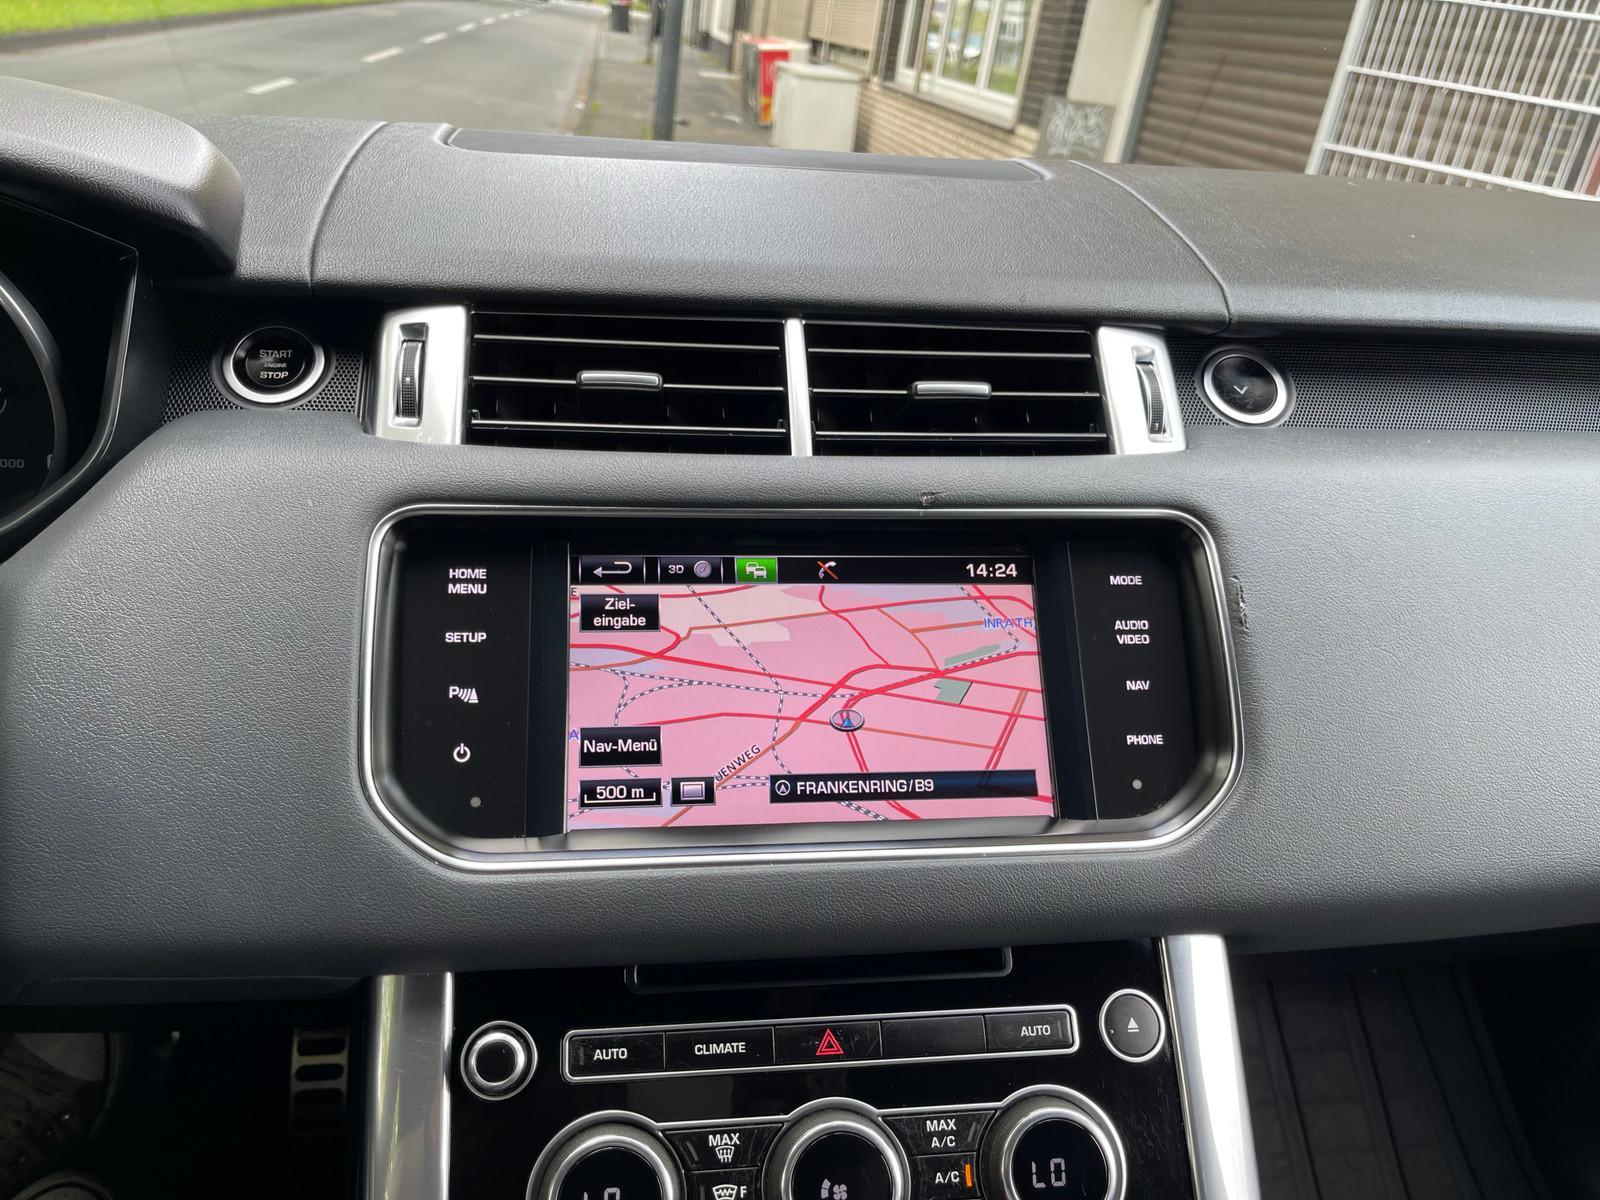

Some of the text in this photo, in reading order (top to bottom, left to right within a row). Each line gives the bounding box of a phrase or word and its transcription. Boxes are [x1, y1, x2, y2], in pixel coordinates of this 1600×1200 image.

[259, 349, 293, 359] START
[259, 371, 289, 379] STOP
[449, 568, 487, 579] HOME
[668, 564, 685, 574] 3D
[966, 563, 1018, 577] 14:24
[1109, 575, 1143, 586] MODE
[448, 583, 487, 594] MENU
[604, 597, 636, 610] Ziel-
[593, 614, 647, 629] eingabe
[1114, 620, 1149, 630] AUDIO
[445, 632, 487, 643] SETUP
[1116, 634, 1150, 645] VIDEO
[1125, 680, 1150, 691] NAV
[583, 739, 659, 753] Nav-Menü
[1126, 734, 1164, 746] PHONE
[596, 785, 645, 800] 500 m
[796, 779, 935, 795] FRANKENRING/B9
[1020, 1025, 1051, 1037] AUTO
[593, 1047, 628, 1061] AUTO
[694, 1042, 747, 1056] CLIMATE
[926, 1118, 957, 1132] MAX
[708, 1133, 741, 1147] MAX
[931, 1136, 956, 1148] A/C
[934, 1170, 960, 1184] A/C
[740, 1185, 748, 1199] F
